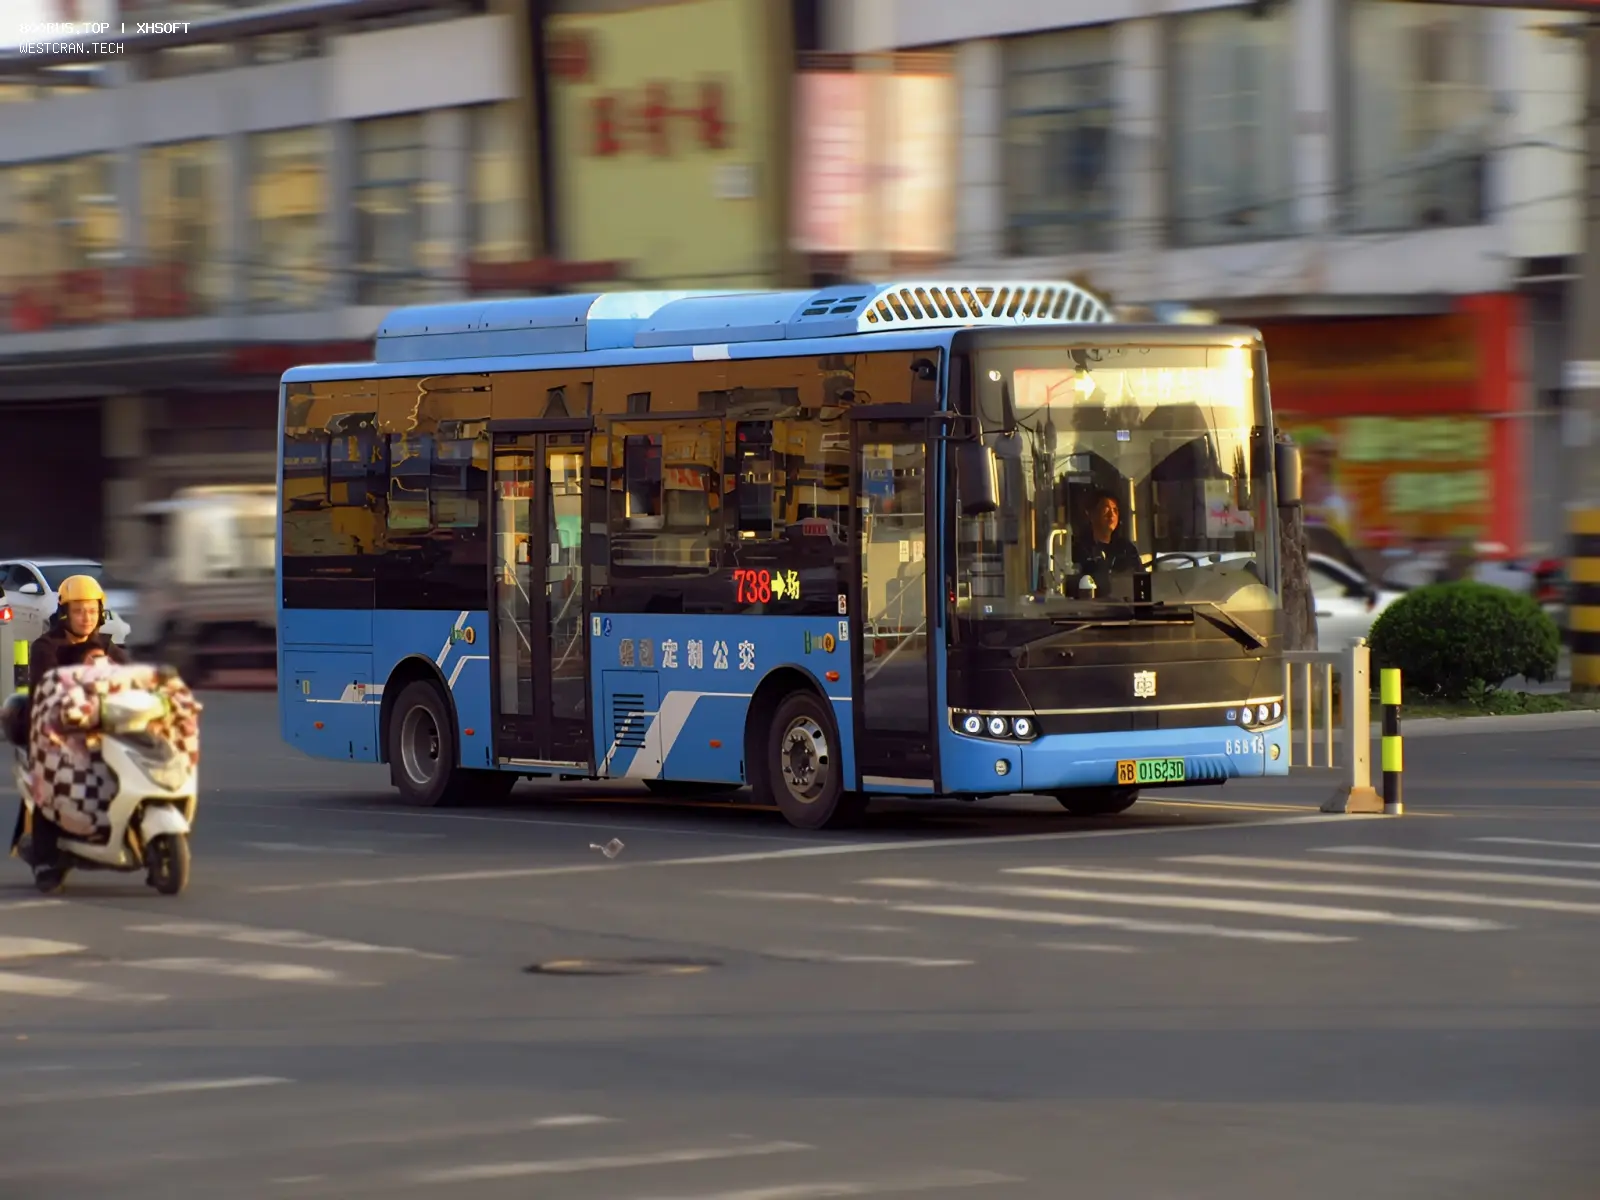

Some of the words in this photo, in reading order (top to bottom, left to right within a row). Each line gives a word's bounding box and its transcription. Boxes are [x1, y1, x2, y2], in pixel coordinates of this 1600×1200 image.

[734, 569, 771, 603] 738
[661, 638, 756, 671] 定制公交
